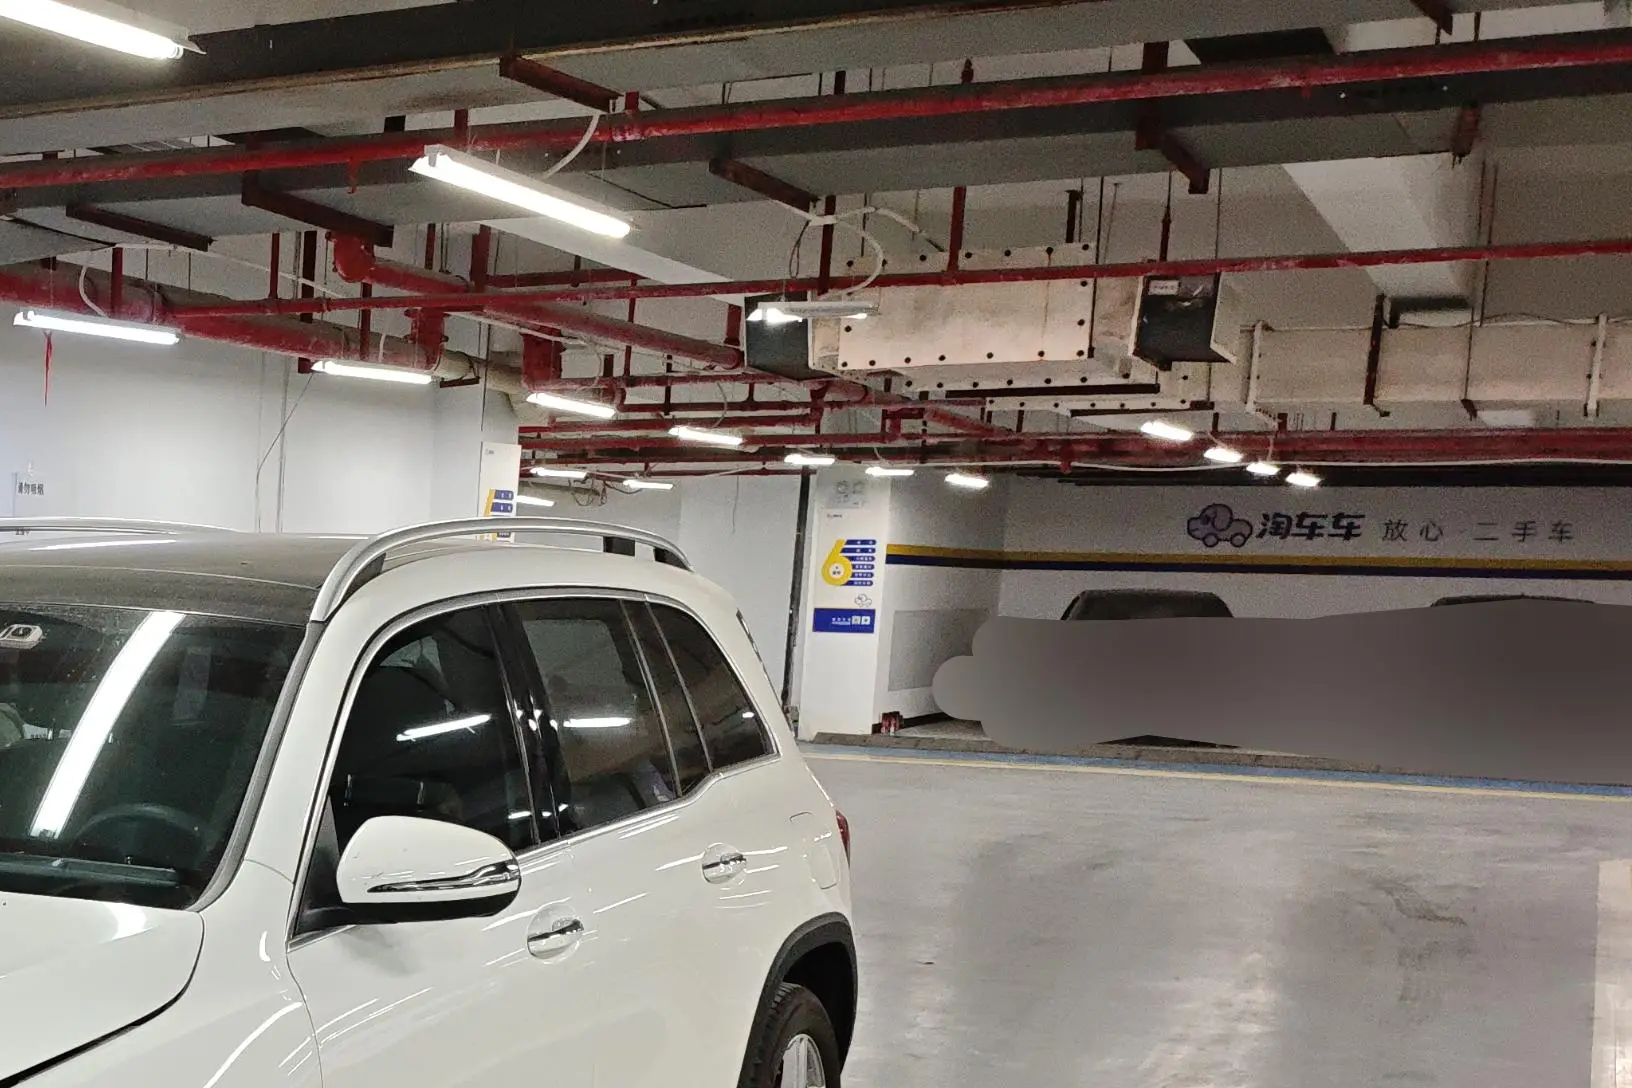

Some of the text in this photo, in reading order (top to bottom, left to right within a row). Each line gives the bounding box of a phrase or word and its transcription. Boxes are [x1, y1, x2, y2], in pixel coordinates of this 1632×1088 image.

[1256, 511, 1574, 543] 淘车车 放心 二手车
